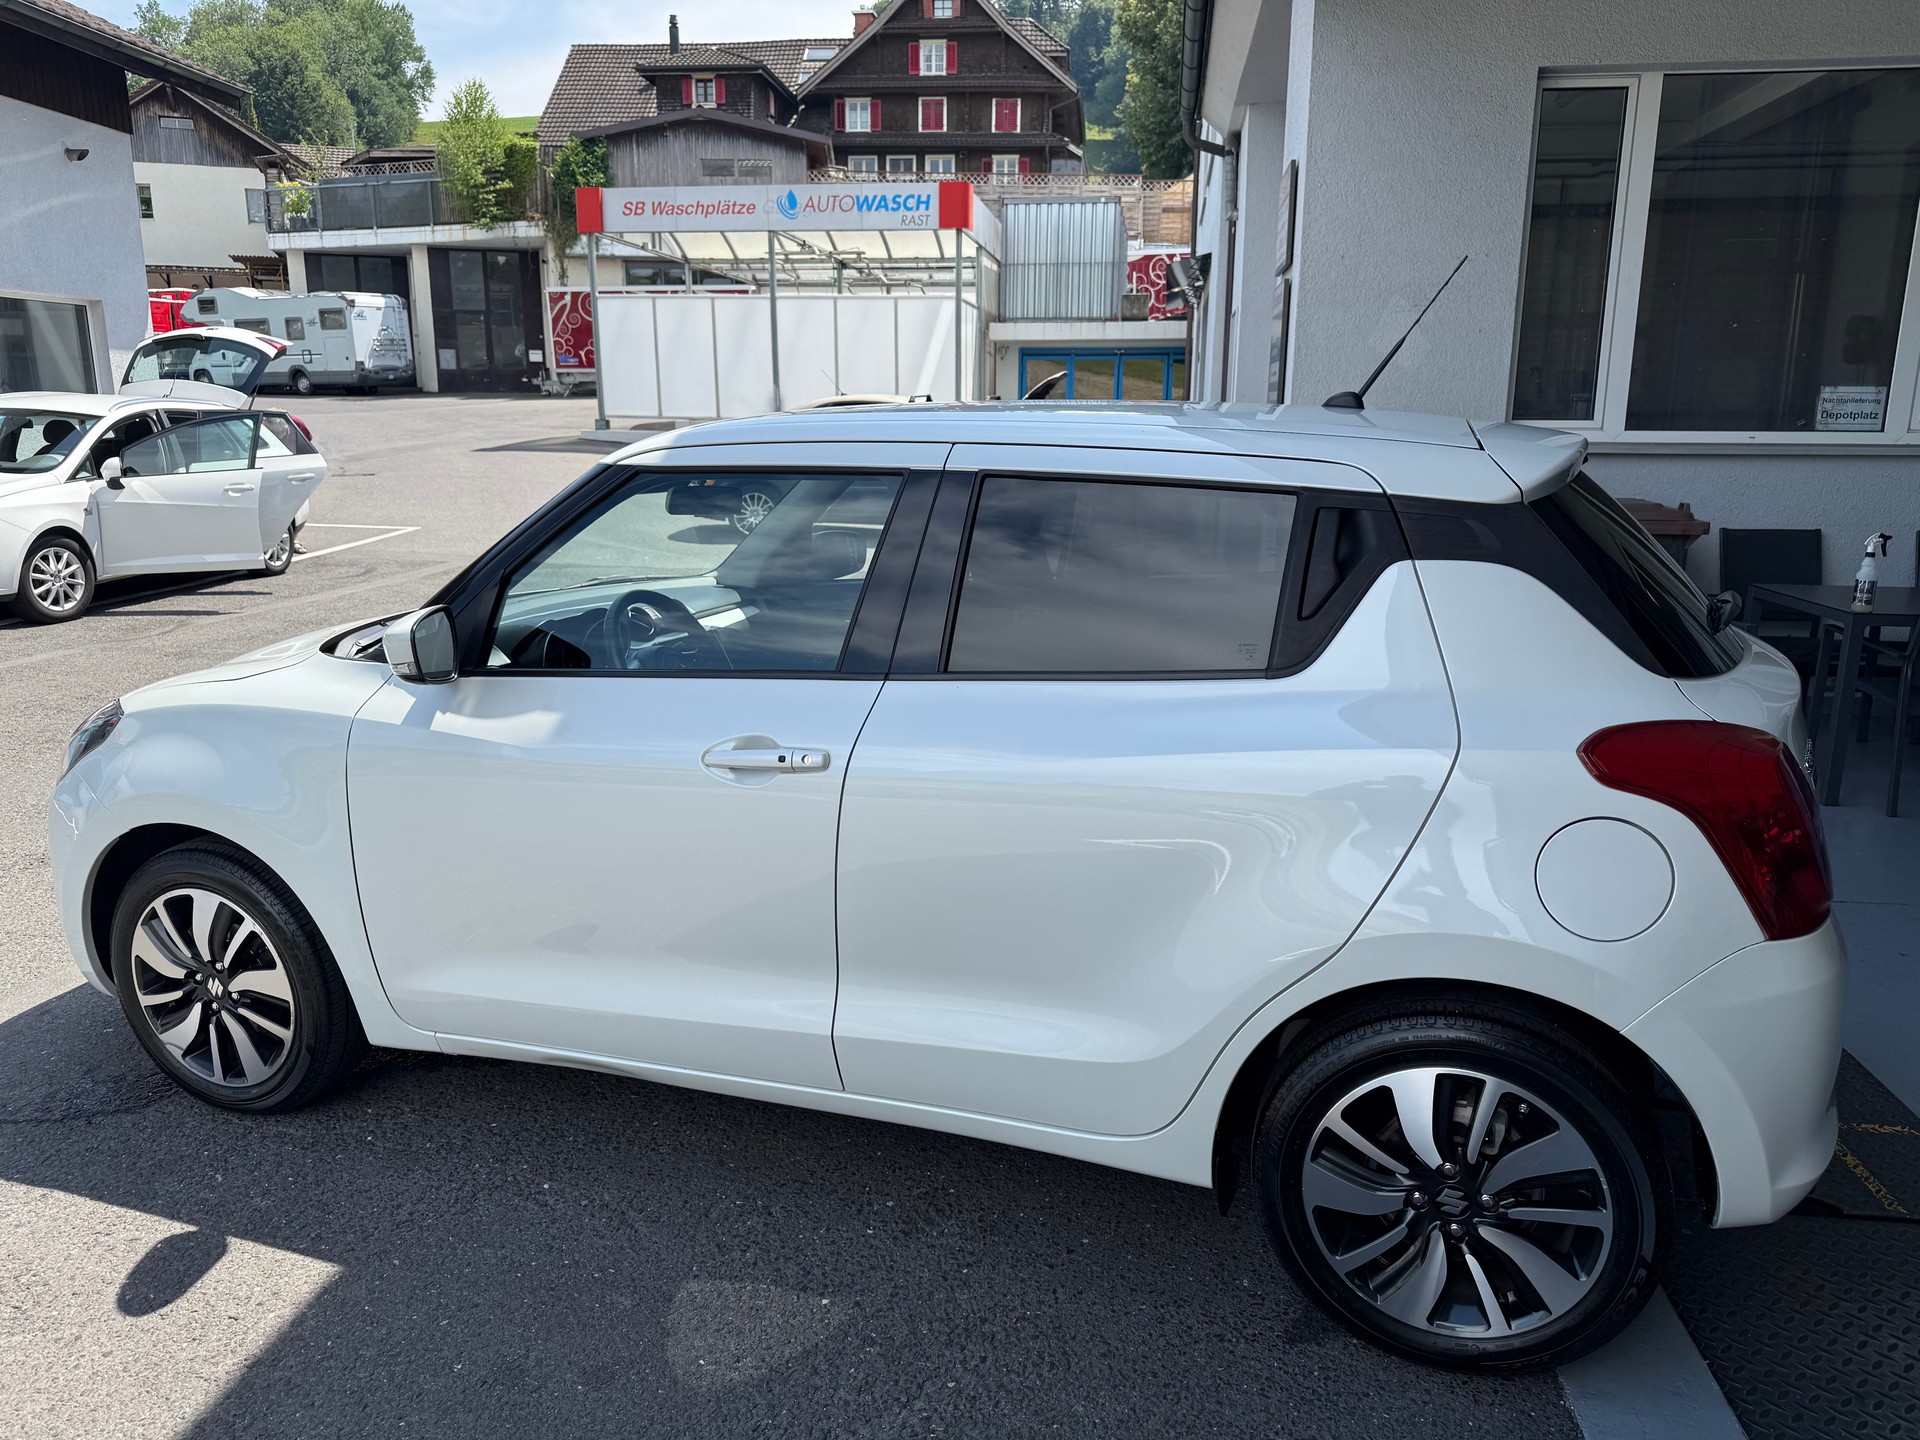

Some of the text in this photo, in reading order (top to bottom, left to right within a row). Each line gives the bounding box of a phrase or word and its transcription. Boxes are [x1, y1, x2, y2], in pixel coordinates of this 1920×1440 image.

[622, 201, 646, 216] SB
[651, 199, 757, 218] Waschplätze
[802, 193, 931, 213] AUTOWASCH
[900, 214, 931, 227] RAST
[1820, 410, 1879, 421] Depotplatz
